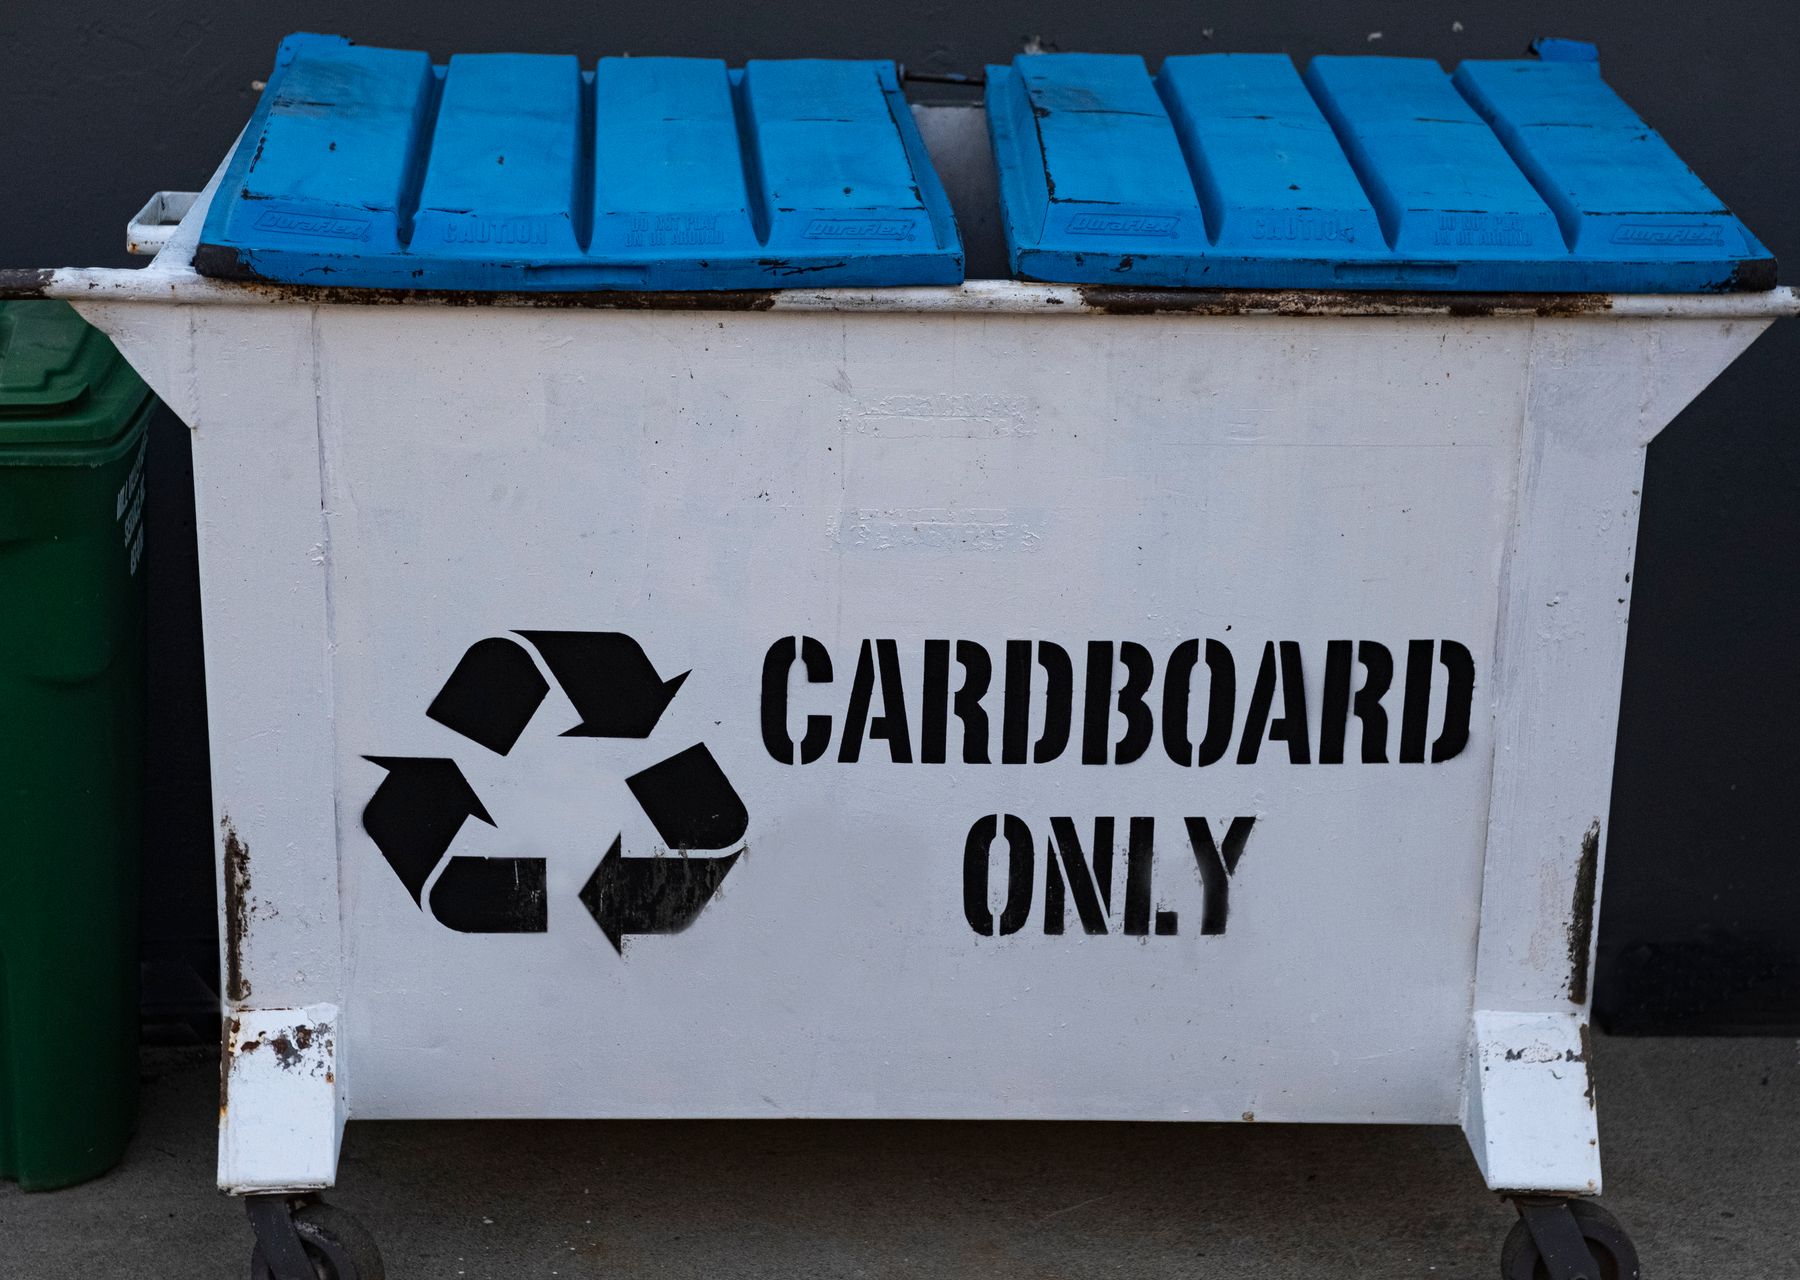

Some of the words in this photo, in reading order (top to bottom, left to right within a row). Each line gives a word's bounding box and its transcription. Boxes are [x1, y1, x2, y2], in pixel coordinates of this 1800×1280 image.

[442, 222, 548, 244] CAUTION
[685, 215, 718, 231] PLAY
[761, 635, 1475, 768] CARDBOARD
[963, 813, 1257, 937] ONLY
